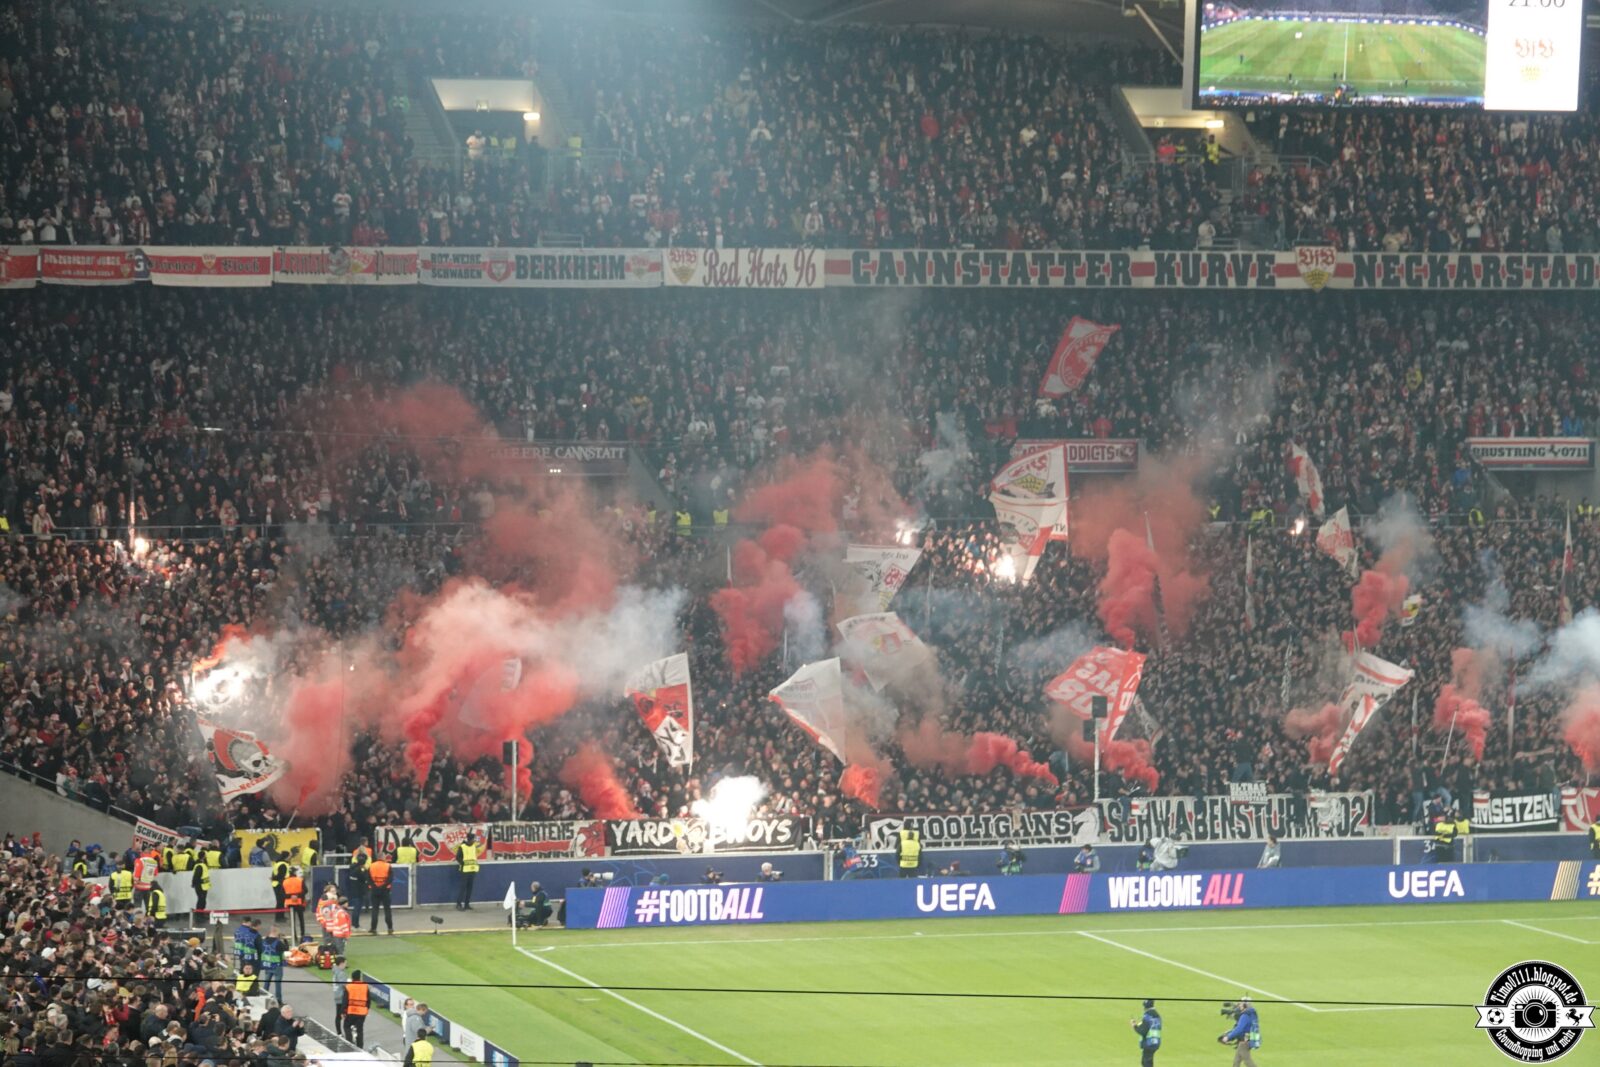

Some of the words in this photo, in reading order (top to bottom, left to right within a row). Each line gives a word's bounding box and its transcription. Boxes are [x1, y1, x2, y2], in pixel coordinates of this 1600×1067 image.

[514, 254, 626, 281] BERKHEIM
[702, 249, 741, 287] Red
[745, 249, 788, 287] Hots
[793, 249, 817, 287] 96
[852, 252, 1133, 286] CANNSTATTER
[1154, 253, 1277, 287] KURVE
[1353, 253, 1599, 287] NECKARSTAD
[554, 446, 626, 461] CANNSTATT
[1068, 445, 1116, 461] DDIGTS
[1561, 447, 1588, 458] 0711
[493, 822, 575, 843] SUPPORTERS
[611, 820, 675, 847] YARD
[904, 812, 1071, 842] HOOLIGANS
[861, 854, 879, 868] 33
[916, 883, 996, 912] UEFA
[1108, 874, 1202, 908] WELCOME
[1202, 873, 1244, 906] ALL
[1388, 870, 1465, 898] UEFA
[635, 887, 763, 922] #FOOTBALL
